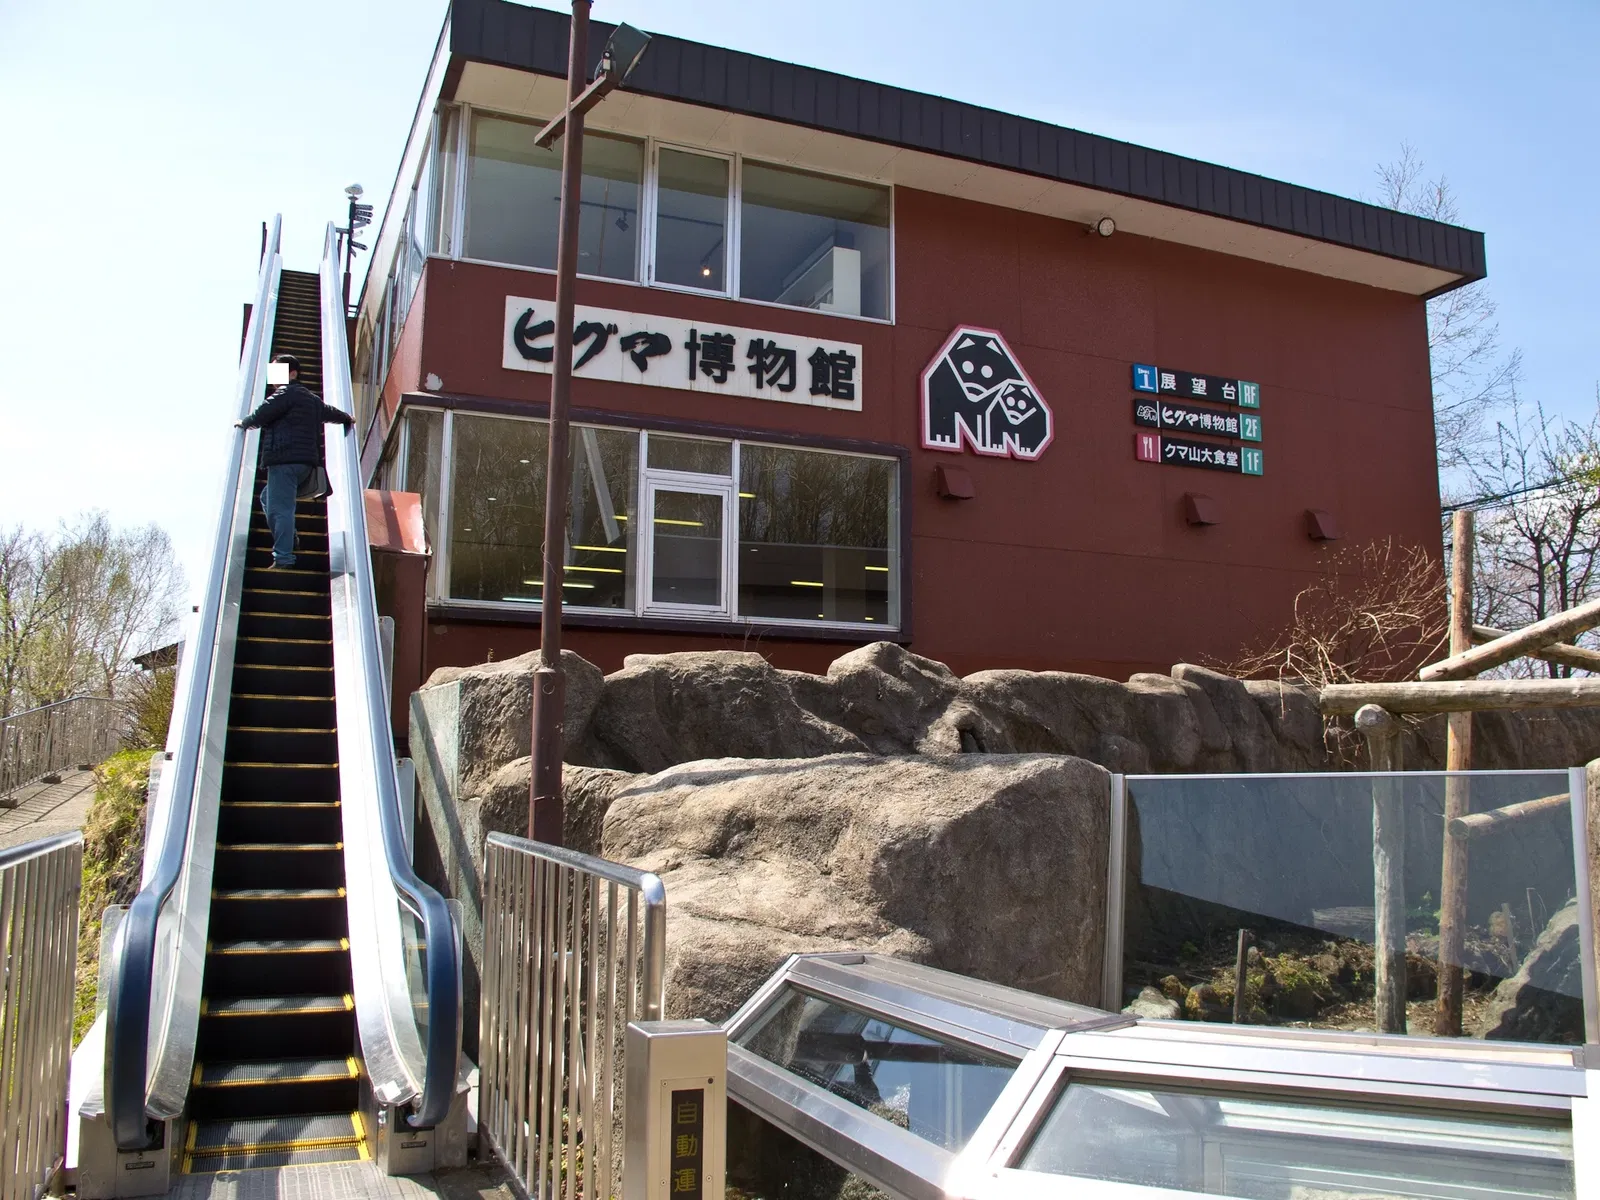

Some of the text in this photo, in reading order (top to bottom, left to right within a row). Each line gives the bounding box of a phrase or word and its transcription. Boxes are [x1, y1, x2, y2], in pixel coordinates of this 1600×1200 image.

[513, 307, 857, 401] ヒグマ博物館
[1160, 372, 1256, 405] 展望台 RF
[1161, 406, 1258, 437] ヒグマ博物館 2F
[1164, 443, 1259, 472] クマ山大食堂 1F
[674, 1101, 698, 1193] 自動運
